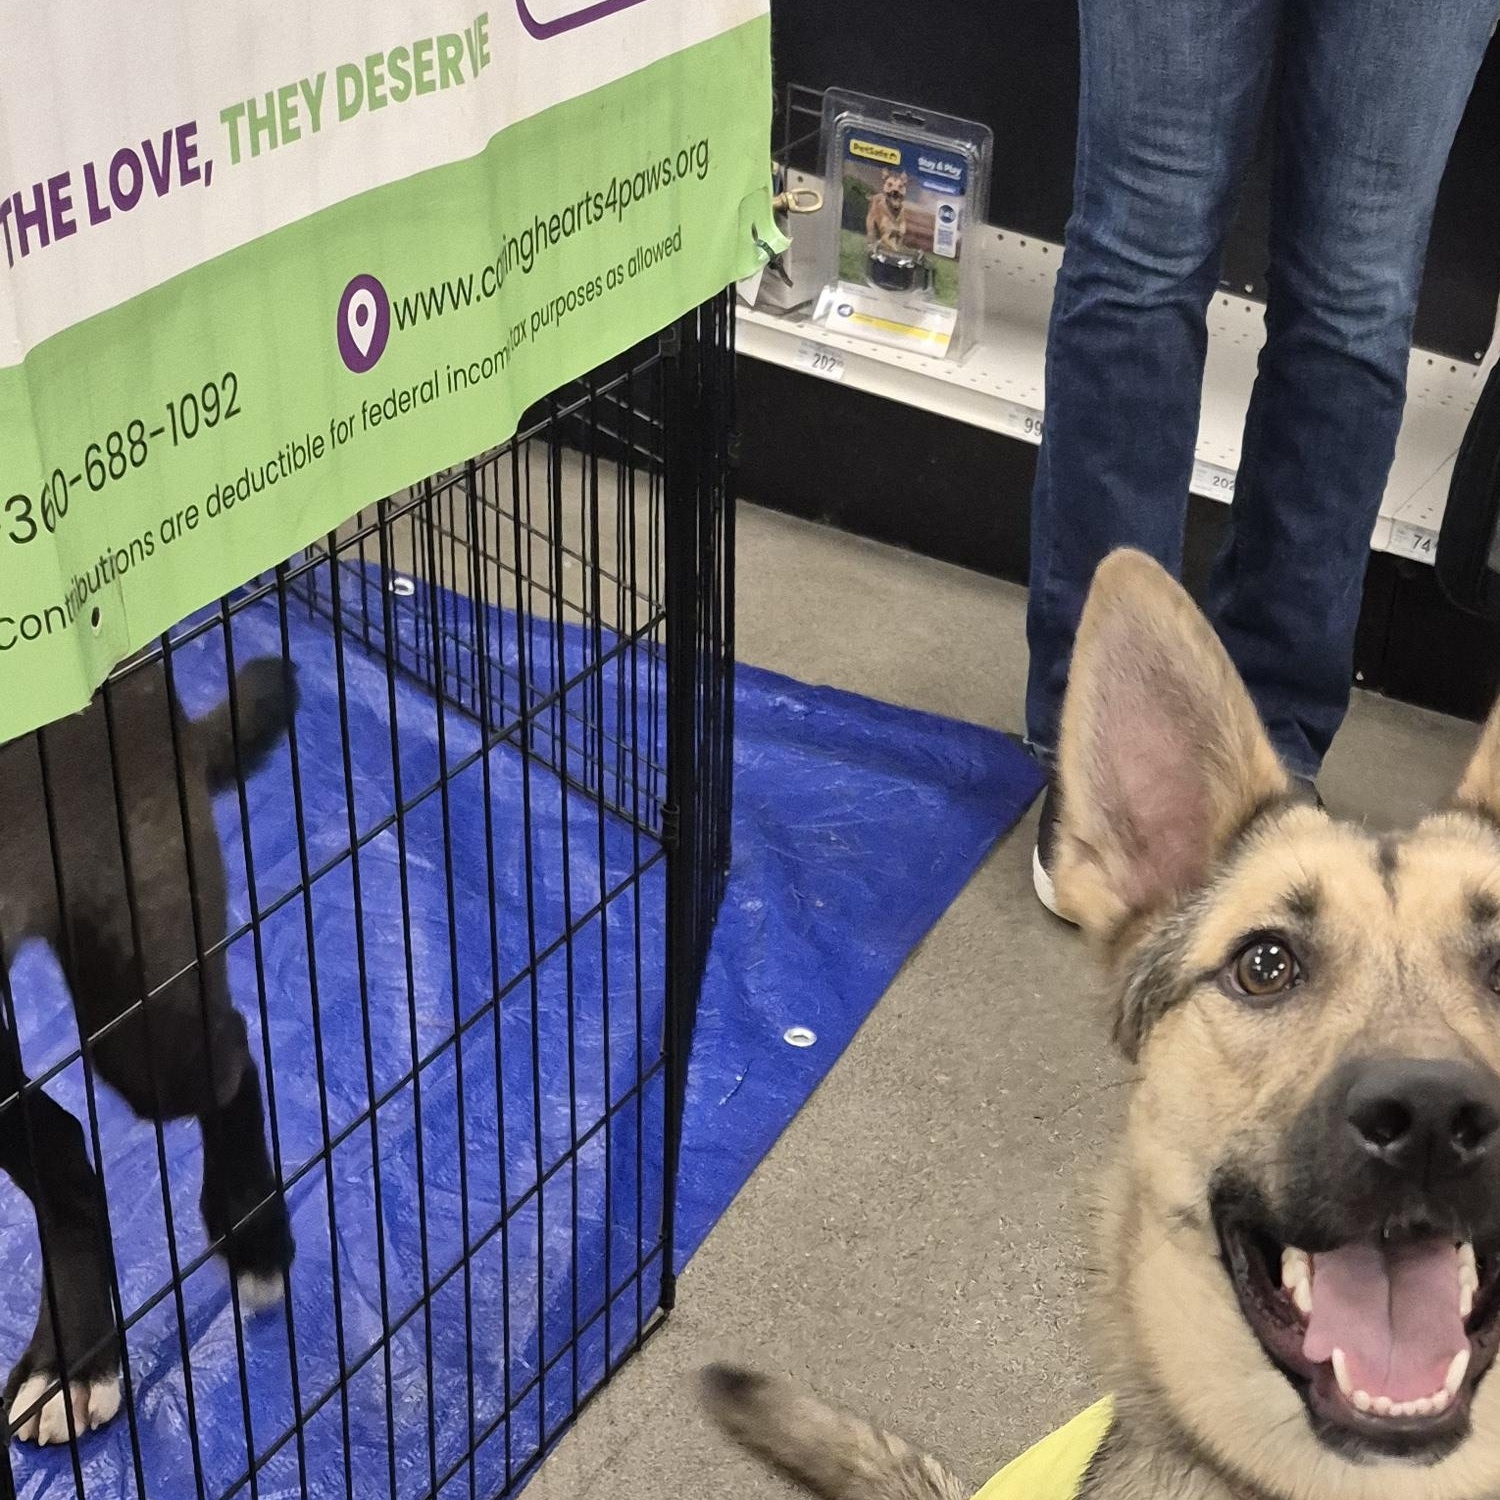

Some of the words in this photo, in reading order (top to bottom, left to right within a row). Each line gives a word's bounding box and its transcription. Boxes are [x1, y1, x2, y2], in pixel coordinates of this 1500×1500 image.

[0, 171, 77, 269] THE
[83, 120, 213, 227] LOVE,
[219, 72, 327, 165] THEY
[335, 12, 491, 122] DESERVE
[393, 138, 709, 331] www.cainghearts4paws.org
[0, 531, 154, 650] Contributions
[160, 504, 199, 544] are
[206, 433, 324, 518] deductible
[329, 412, 355, 449] for
[361, 369, 439, 431] federal
[446, 345, 512, 394] incom
[531, 275, 602, 343] purposes
[607, 263, 624, 290] as
[628, 225, 682, 277] allowed
[4, 372, 241, 544] 360-688-1092
